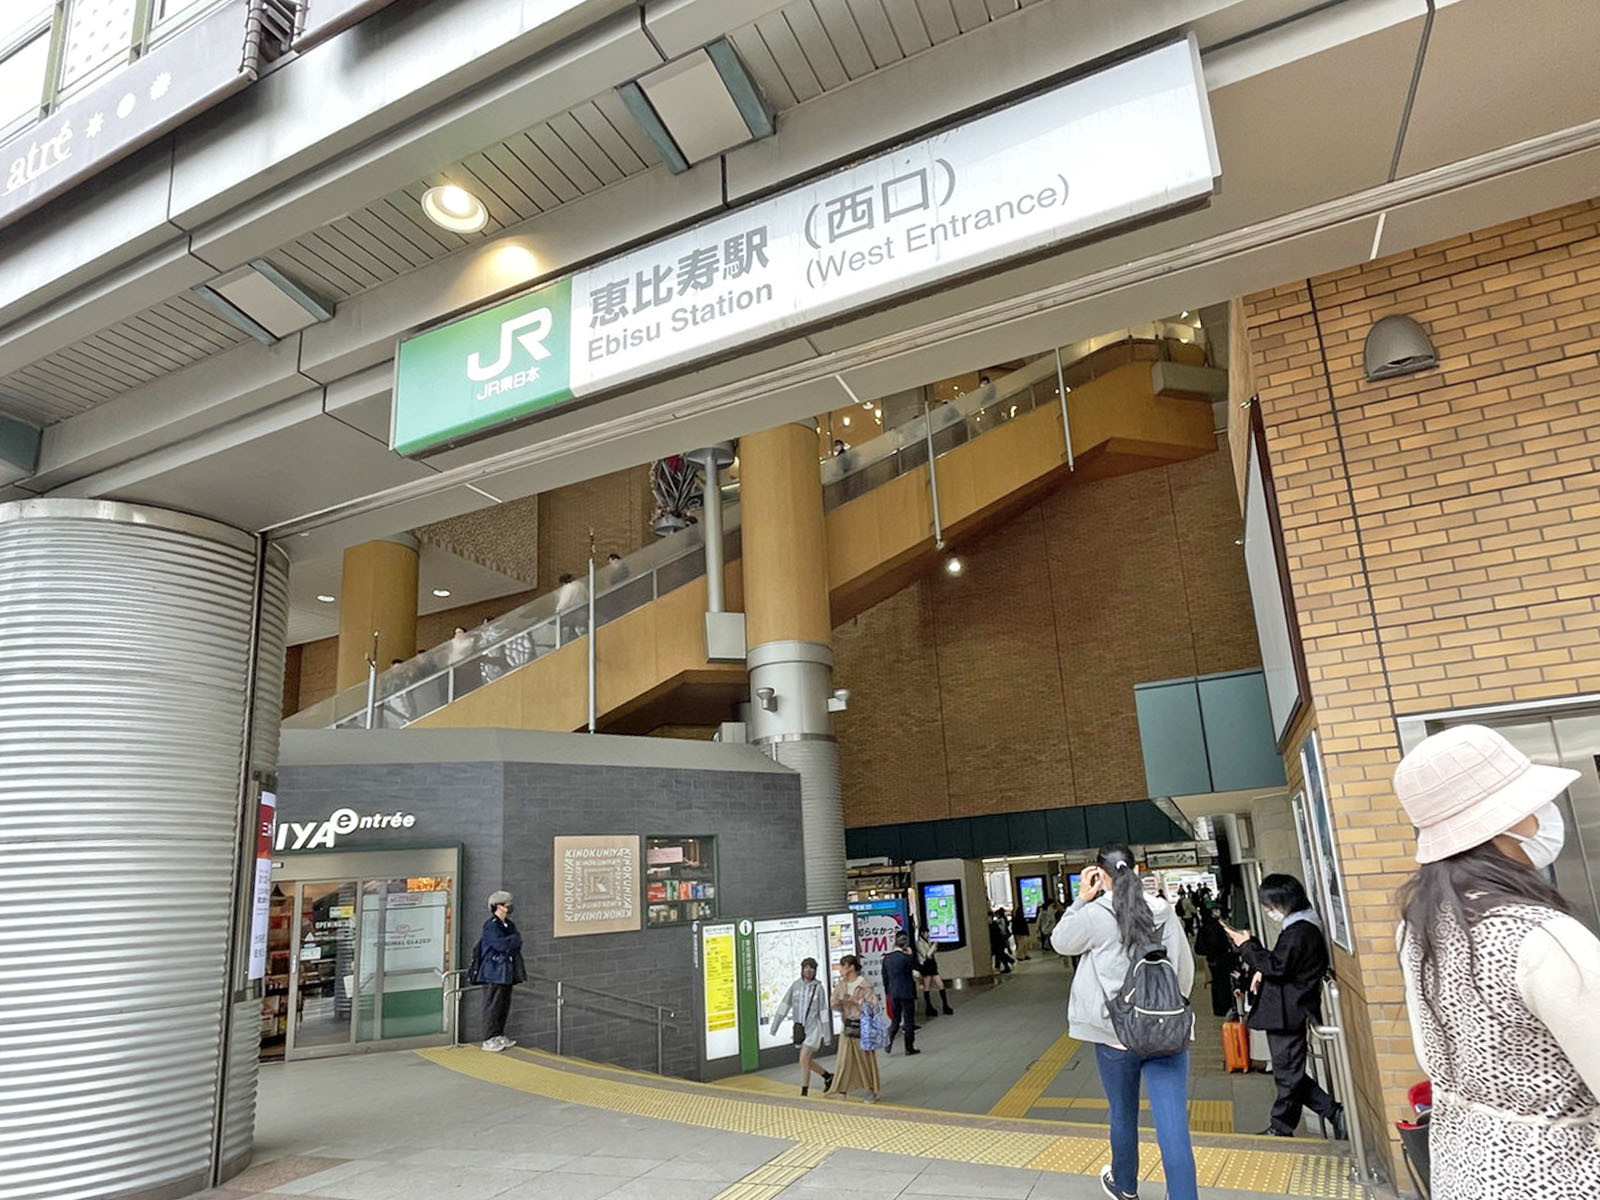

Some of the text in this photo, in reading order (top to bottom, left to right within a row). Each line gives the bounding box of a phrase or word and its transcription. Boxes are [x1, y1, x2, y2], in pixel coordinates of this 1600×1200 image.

[5, 120, 73, 191] atré
[587, 173, 1070, 362] Ebisu Station (West Entrance)
[588, 157, 956, 329] 恵比寿駅 (西口)
[466, 306, 553, 381] JR
[476, 366, 541, 401] JR東日本
[330, 807, 416, 835] entrée
[565, 847, 624, 858] KINOKUNIYA
[564, 857, 575, 922] KINOKUNIYA
[622, 848, 632, 911] KINOKUNIYA
[574, 910, 632, 921] KINOKUNIYA
